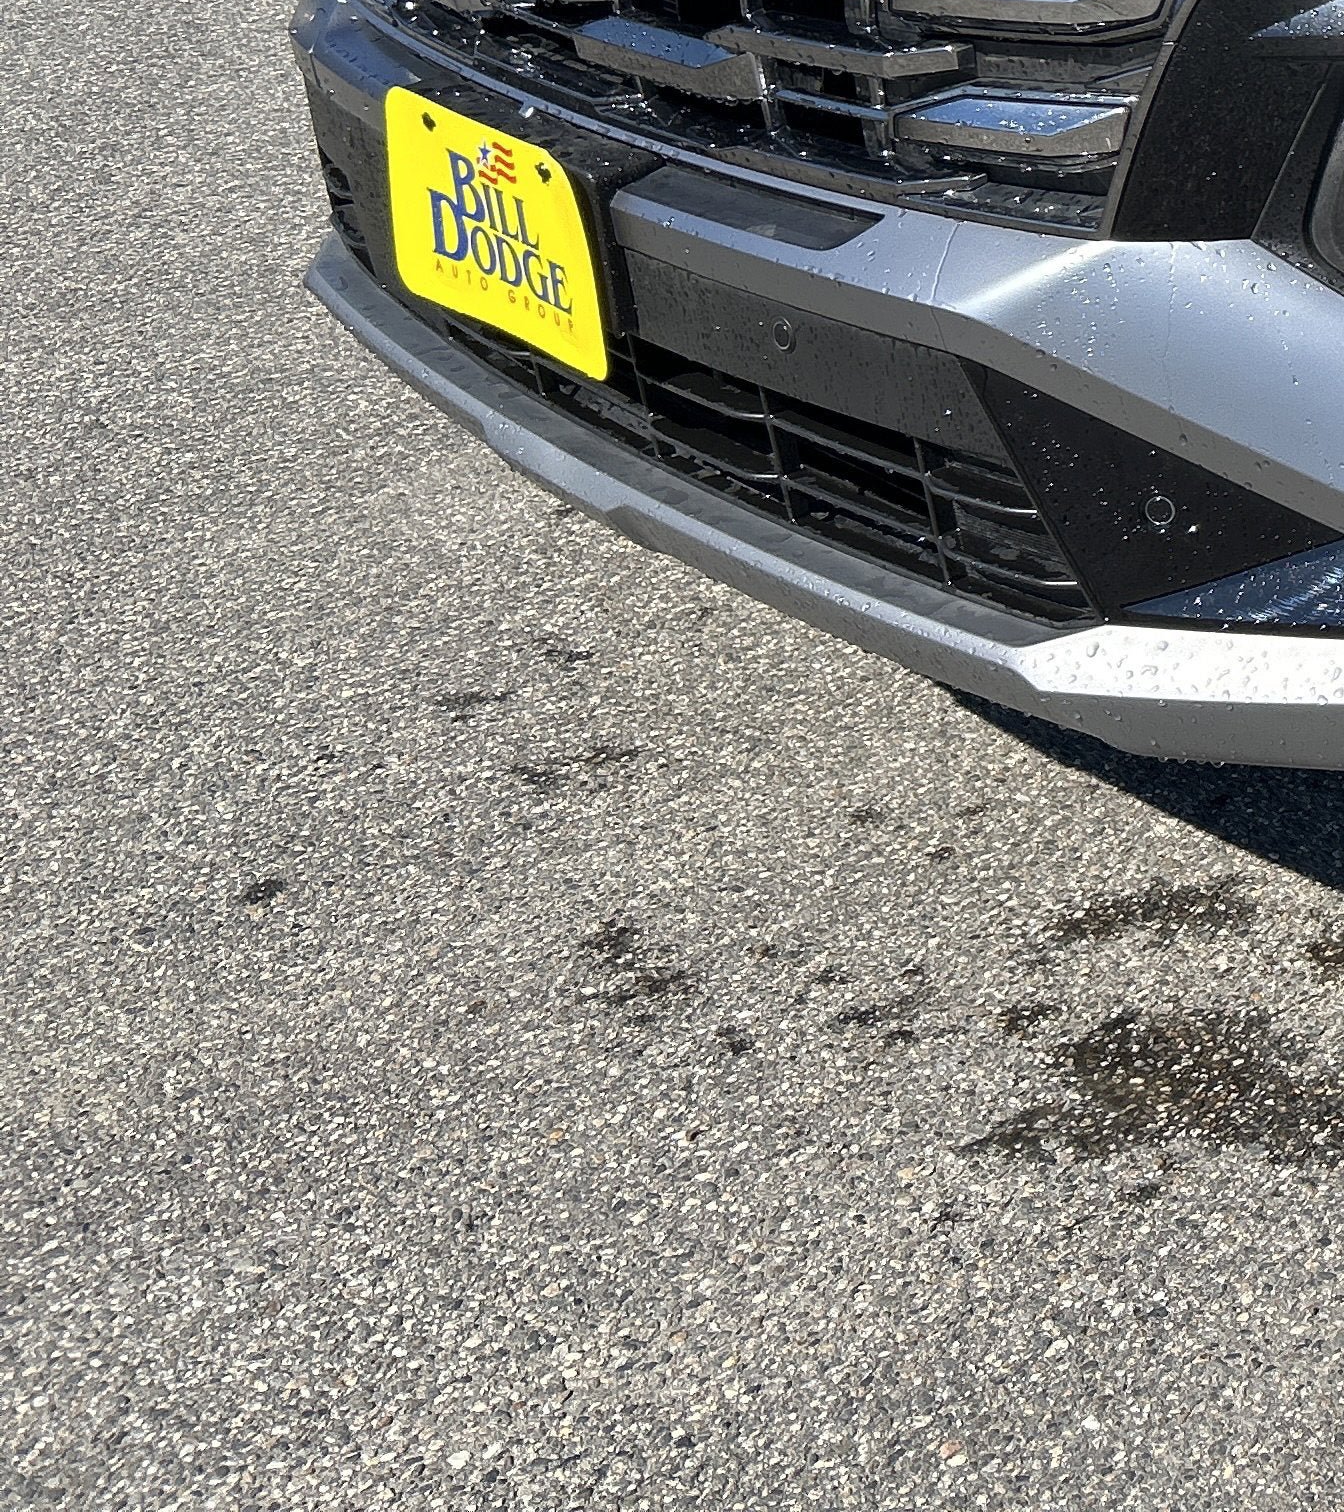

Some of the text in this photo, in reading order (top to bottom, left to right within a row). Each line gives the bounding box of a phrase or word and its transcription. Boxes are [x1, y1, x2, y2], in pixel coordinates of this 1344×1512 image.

[426, 187, 574, 315] DODGE
[445, 147, 541, 251] BILL
[435, 259, 575, 331] AUTO GROUP
